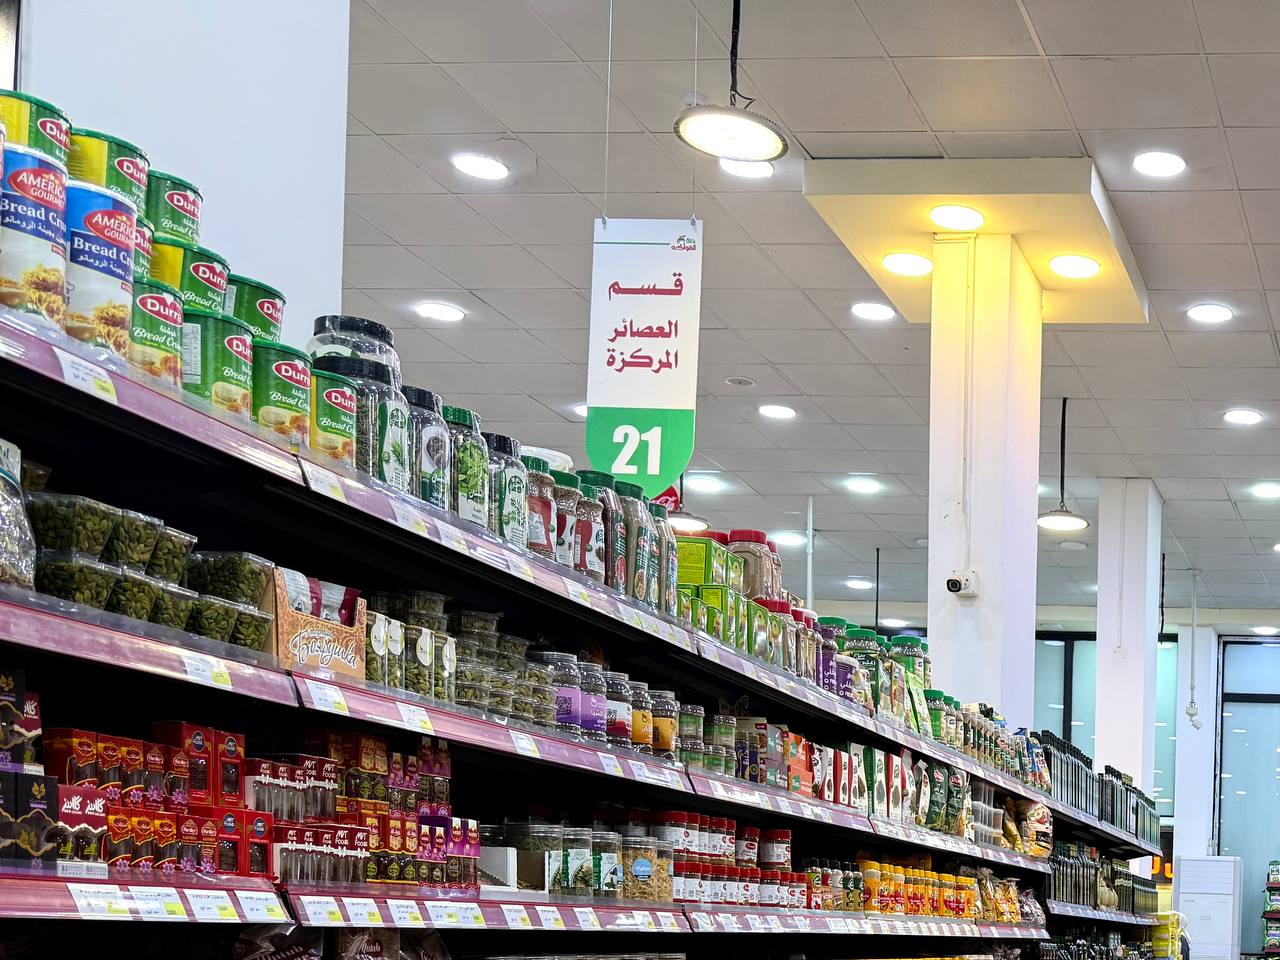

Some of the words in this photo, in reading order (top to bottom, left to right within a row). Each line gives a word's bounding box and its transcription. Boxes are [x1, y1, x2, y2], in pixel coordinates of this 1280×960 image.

[93, 213, 134, 236] AMERIC
[74, 237, 116, 258] Bread
[608, 272, 684, 302] قسم
[133, 327, 165, 343] Bread
[608, 319, 678, 342] العصائر
[606, 348, 678, 373] المركزة
[270, 391, 297, 406] Bread
[320, 417, 347, 429] Bread
[611, 425, 662, 475] 21
